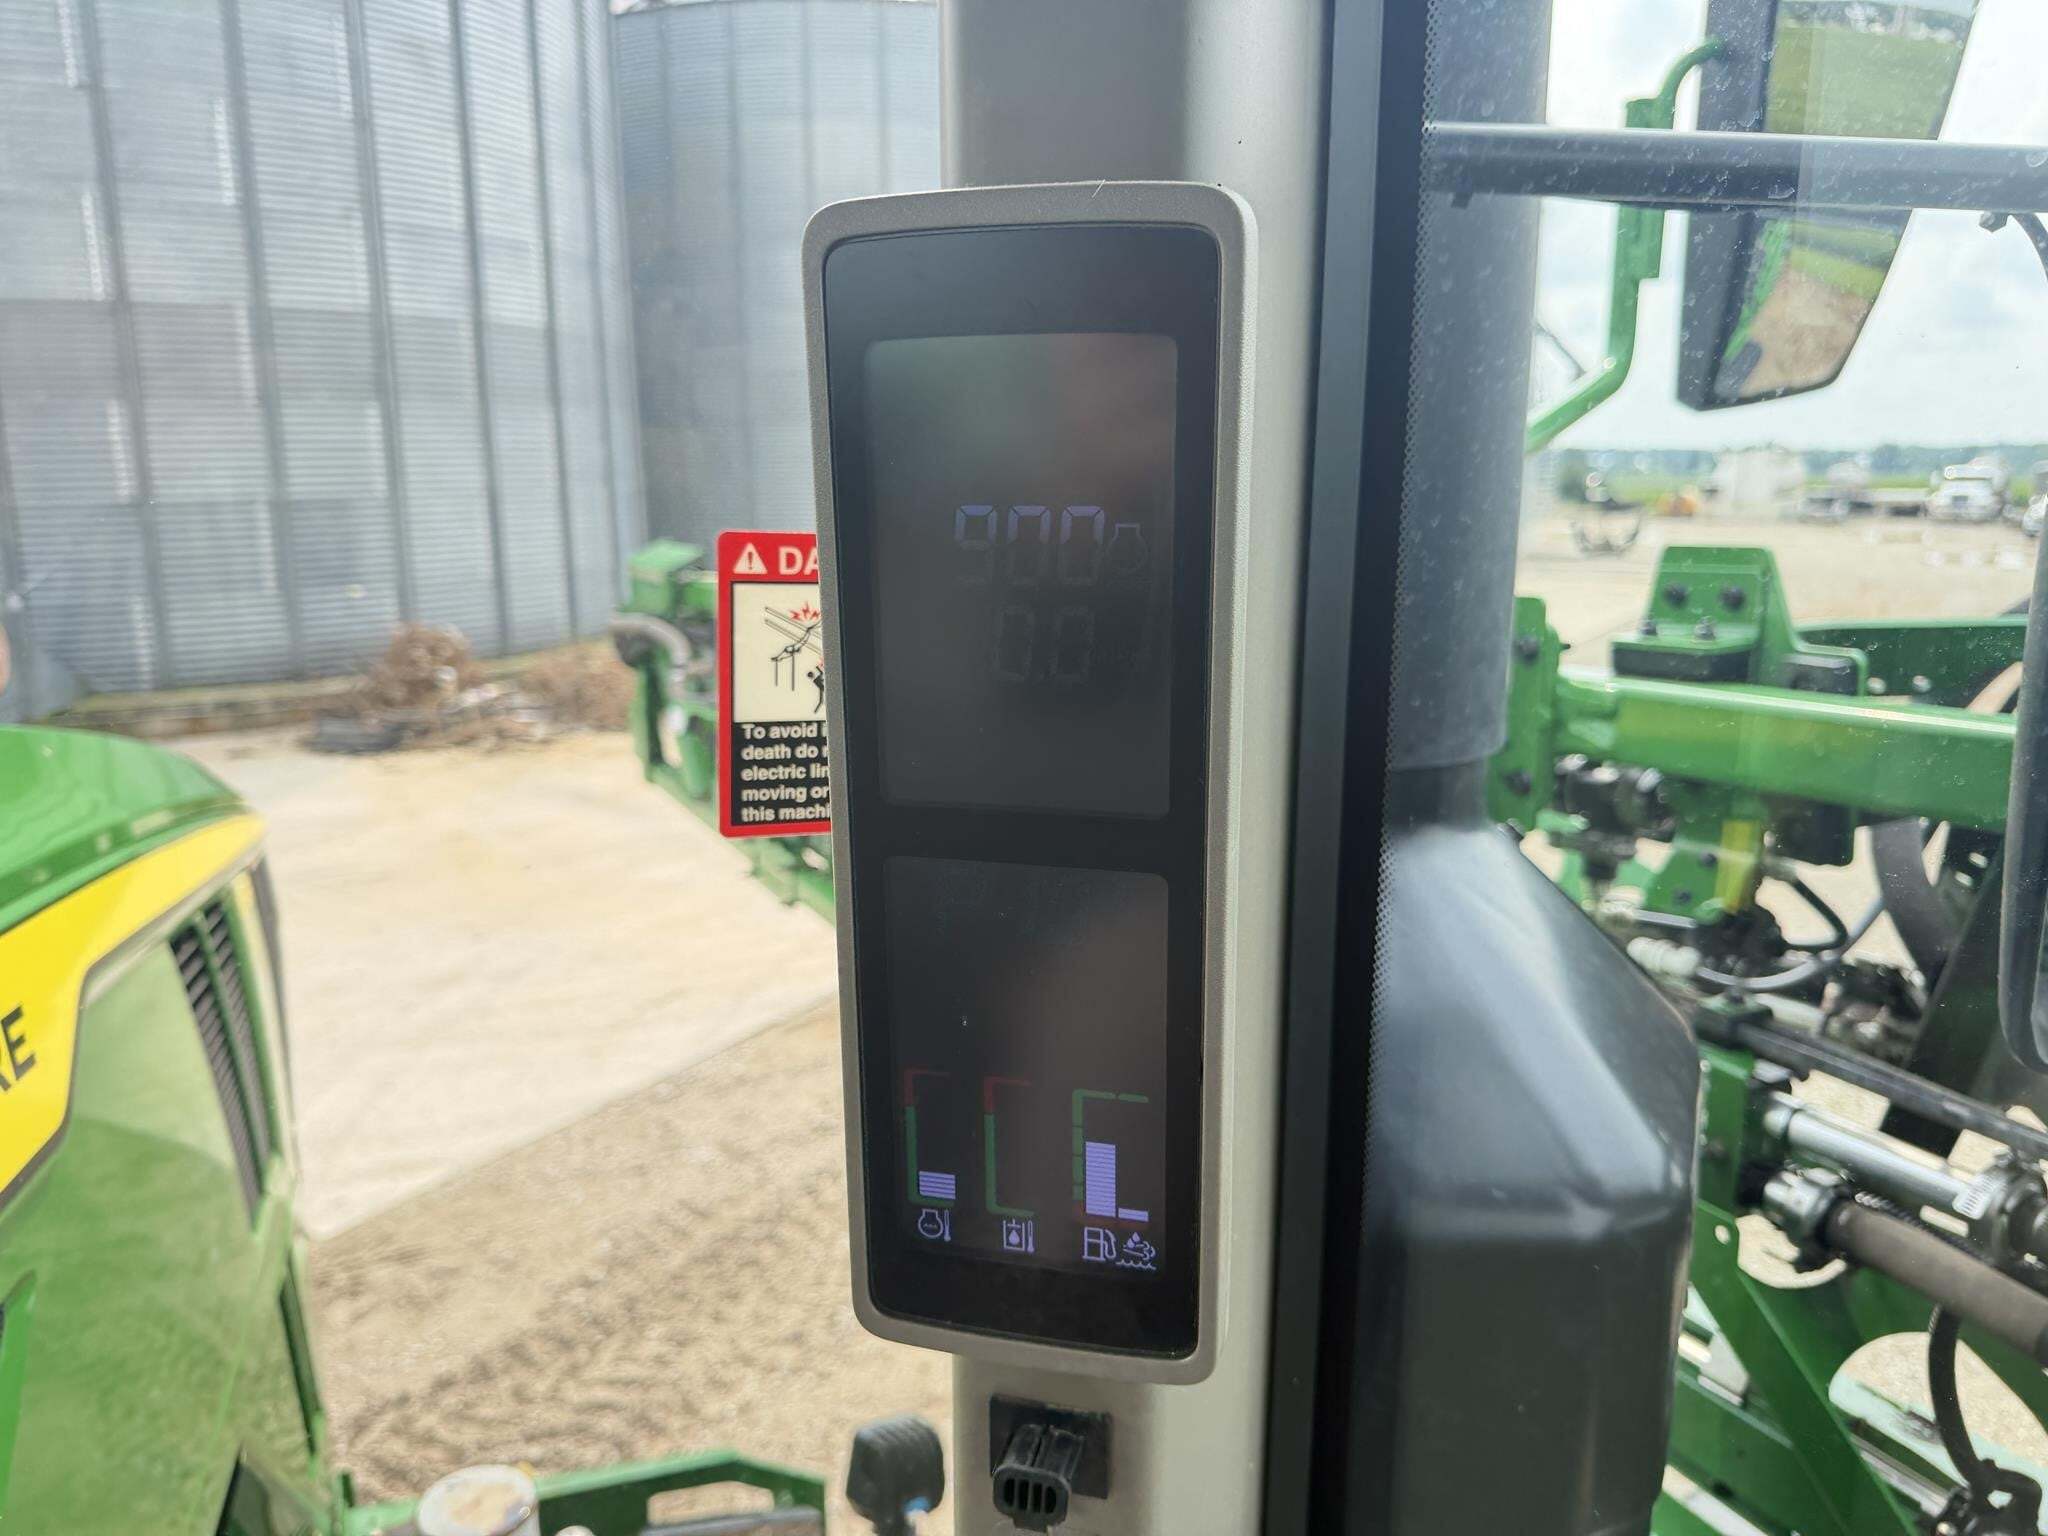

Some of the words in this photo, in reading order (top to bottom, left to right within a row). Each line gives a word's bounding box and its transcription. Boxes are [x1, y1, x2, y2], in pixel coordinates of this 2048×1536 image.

[953, 505, 1105, 585] 900
[742, 724, 766, 739] To
[769, 722, 818, 738] avoid
[741, 744, 791, 760] death
[794, 743, 819, 758] do
[741, 763, 807, 781] electric
[741, 784, 807, 803] moving
[741, 805, 775, 822] this
